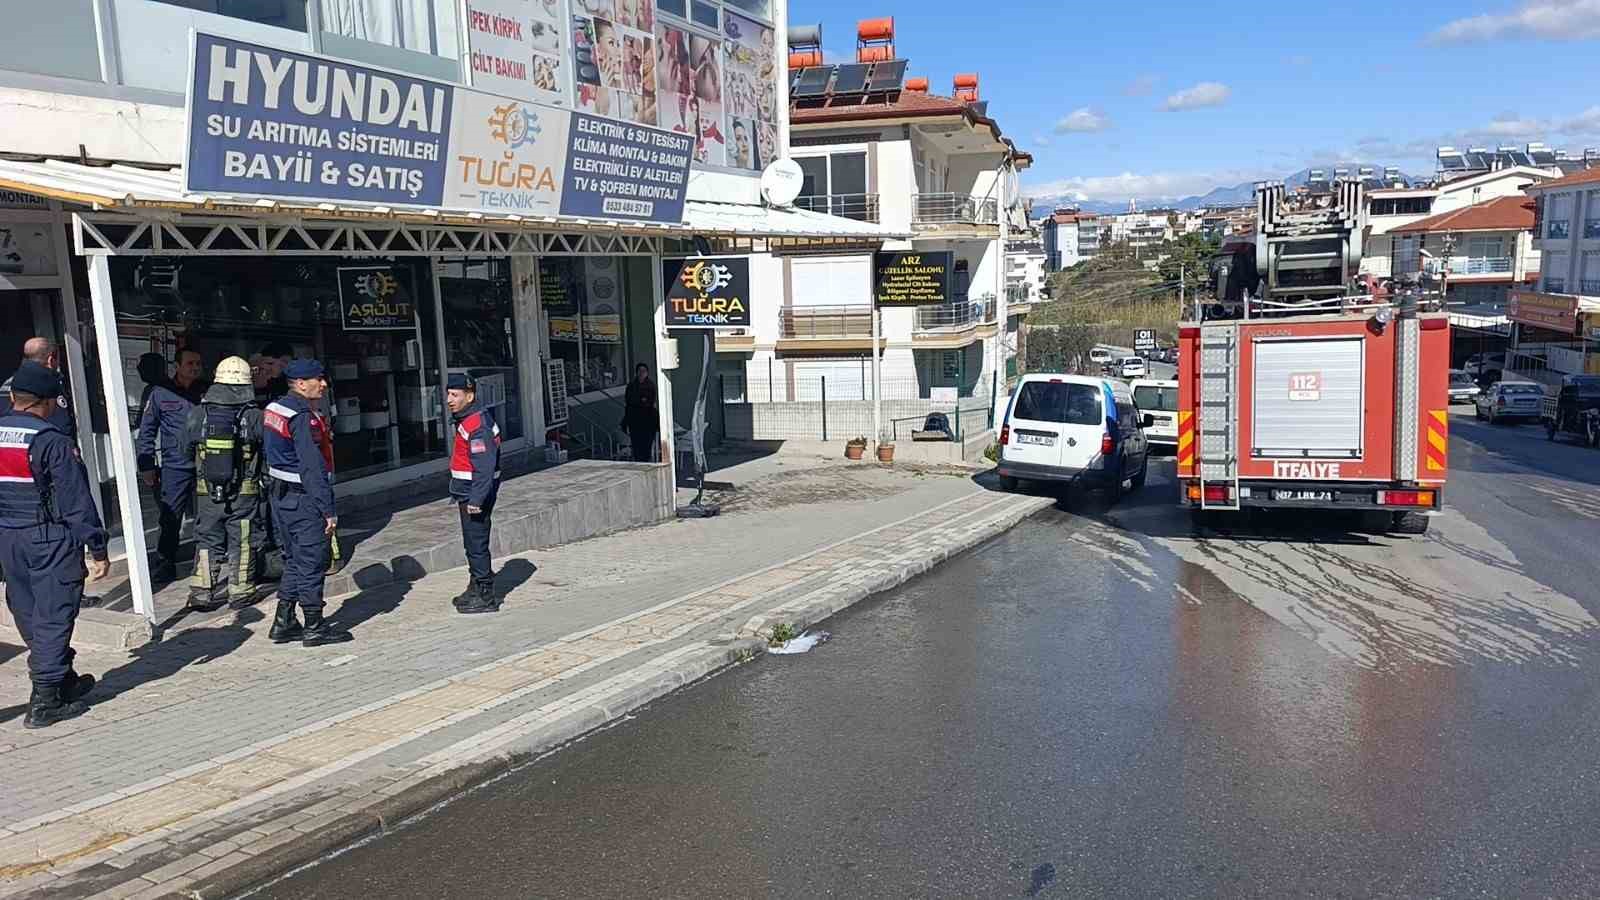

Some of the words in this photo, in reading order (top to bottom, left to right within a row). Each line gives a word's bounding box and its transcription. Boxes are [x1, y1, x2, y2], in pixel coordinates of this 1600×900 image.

[493, 13, 523, 41] KİRPİK
[473, 48, 492, 73] CİLT
[495, 57, 526, 80] BAKIMI
[207, 44, 445, 134] HYUNDAI
[207, 114, 241, 138] SU
[247, 119, 332, 148] ARITMA
[337, 127, 439, 161] SİSTEMLERİ
[577, 118, 626, 139] ELEKTRİK
[627, 128, 634, 141] &
[635, 129, 649, 143] SU
[651, 133, 689, 151] TESİSATI
[573, 136, 607, 155] KLİMA
[609, 143, 649, 161] MONTAJ
[651, 151, 658, 163] &
[659, 153, 688, 168] BAKIM
[224, 151, 313, 183] BAYİİ
[320, 160, 341, 185] &
[347, 162, 423, 198] SATIŞ
[458, 150, 556, 192] TUĞRA
[573, 157, 629, 177] ELEKTRİKLİ
[630, 166, 643, 179] EV
[643, 168, 684, 184] ALETLERİ
[479, 190, 535, 208] TEKNİK
[574, 176, 589, 191] TV
[590, 179, 598, 192] &
[600, 180, 637, 196] ŞOFBEN
[638, 184, 679, 201] MONTAJI
[901, 256, 921, 265] ARZ
[670, 292, 745, 313] TUĞRA
[687, 312, 729, 324] TEKNİK
[1292, 375, 1317, 390] 112
[1273, 460, 1340, 480] İTFAİYE
